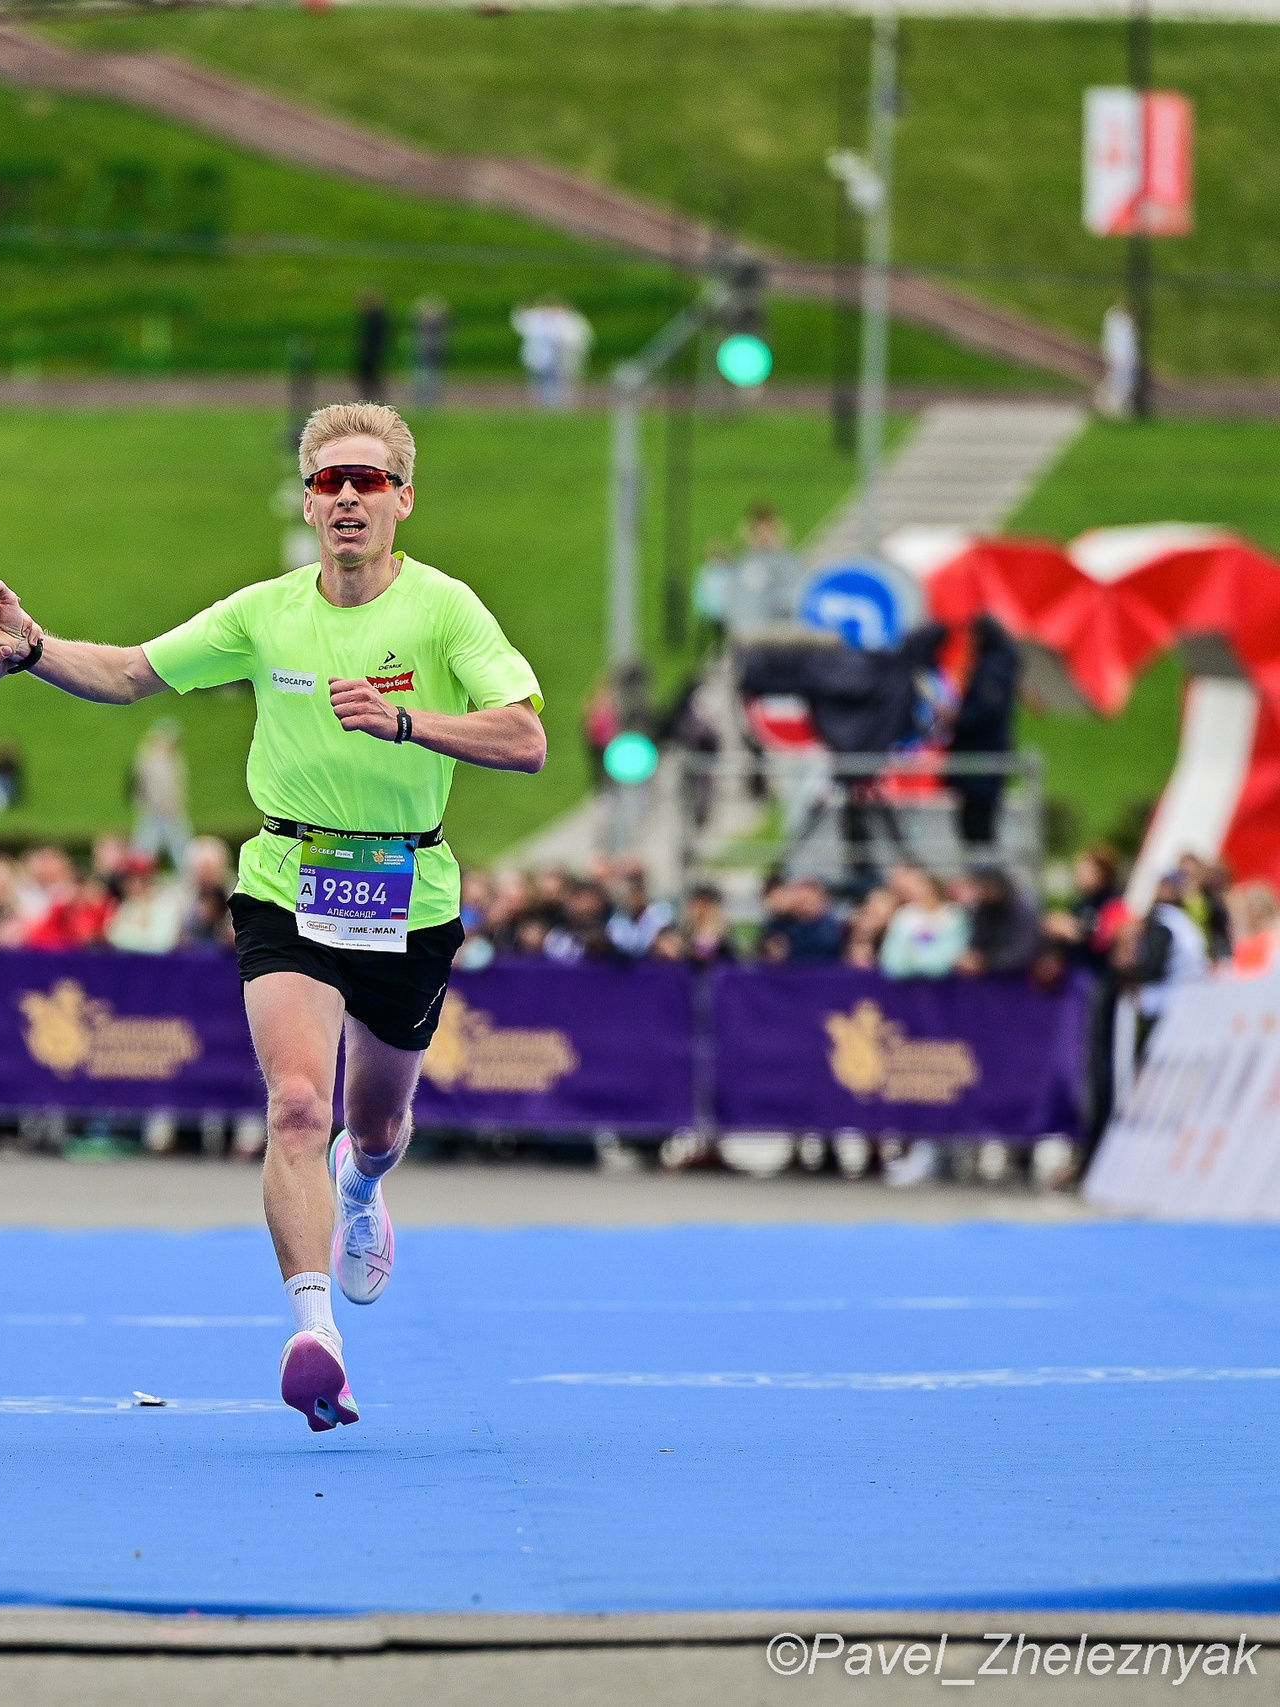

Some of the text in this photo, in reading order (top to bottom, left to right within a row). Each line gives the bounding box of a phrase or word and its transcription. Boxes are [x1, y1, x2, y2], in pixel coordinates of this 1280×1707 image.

[378, 663, 403, 671] DEMIX
[278, 676, 313, 687] ФОСАГРО
[300, 867, 316, 875] 2025
[322, 878, 387, 905] 9384
[326, 907, 377, 919] АЛЕКСАНДР
